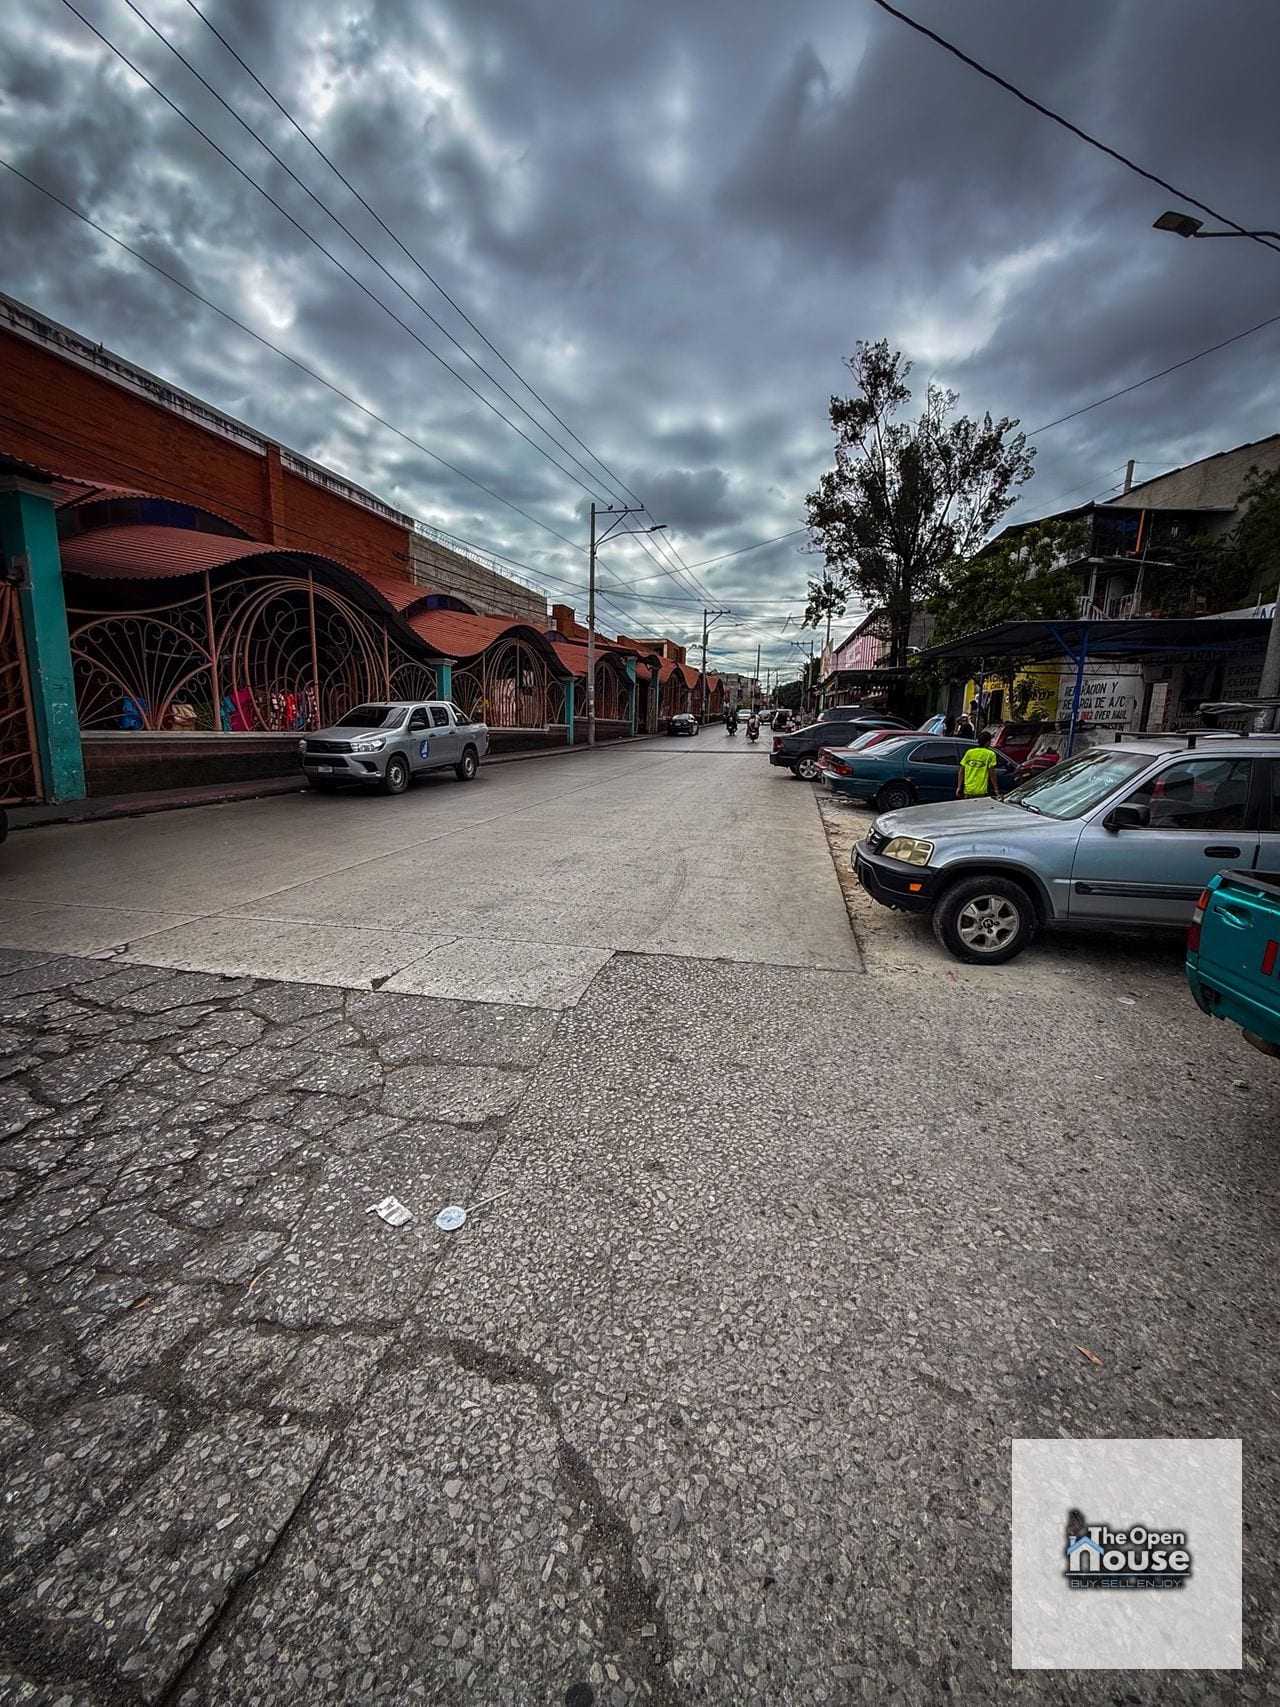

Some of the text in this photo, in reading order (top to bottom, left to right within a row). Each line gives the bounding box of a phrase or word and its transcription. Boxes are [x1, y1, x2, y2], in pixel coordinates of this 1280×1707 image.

[1229, 664, 1264, 675] FRENO
[1111, 681, 1118, 693] Y
[1094, 697, 1106, 708] DE
[1108, 695, 1126, 708] A/C
[1095, 711, 1110, 720] OVER
[1112, 710, 1127, 720] HAUL
